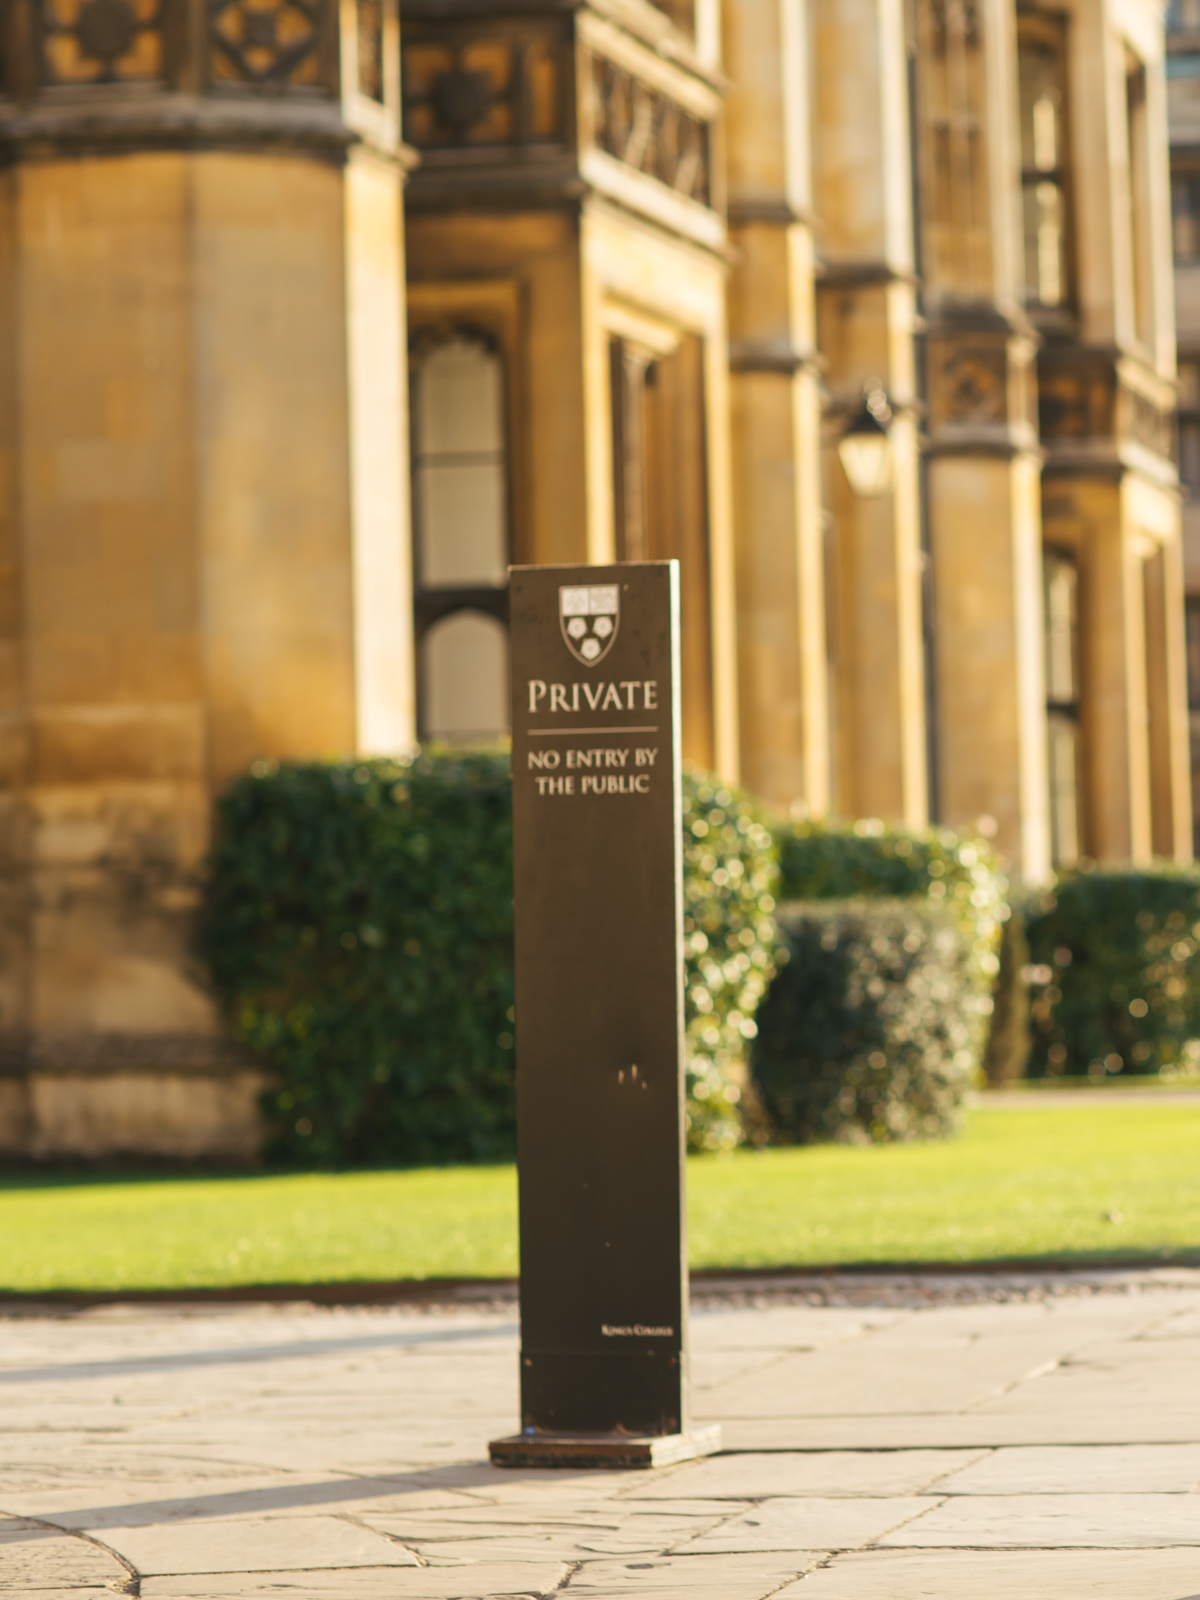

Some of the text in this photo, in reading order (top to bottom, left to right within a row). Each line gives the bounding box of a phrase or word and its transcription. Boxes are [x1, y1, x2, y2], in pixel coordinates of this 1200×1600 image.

[528, 679, 659, 713] PRIVATE
[527, 747, 658, 770] NO ENTRY BY
[535, 773, 650, 796] THE PUBLIC
